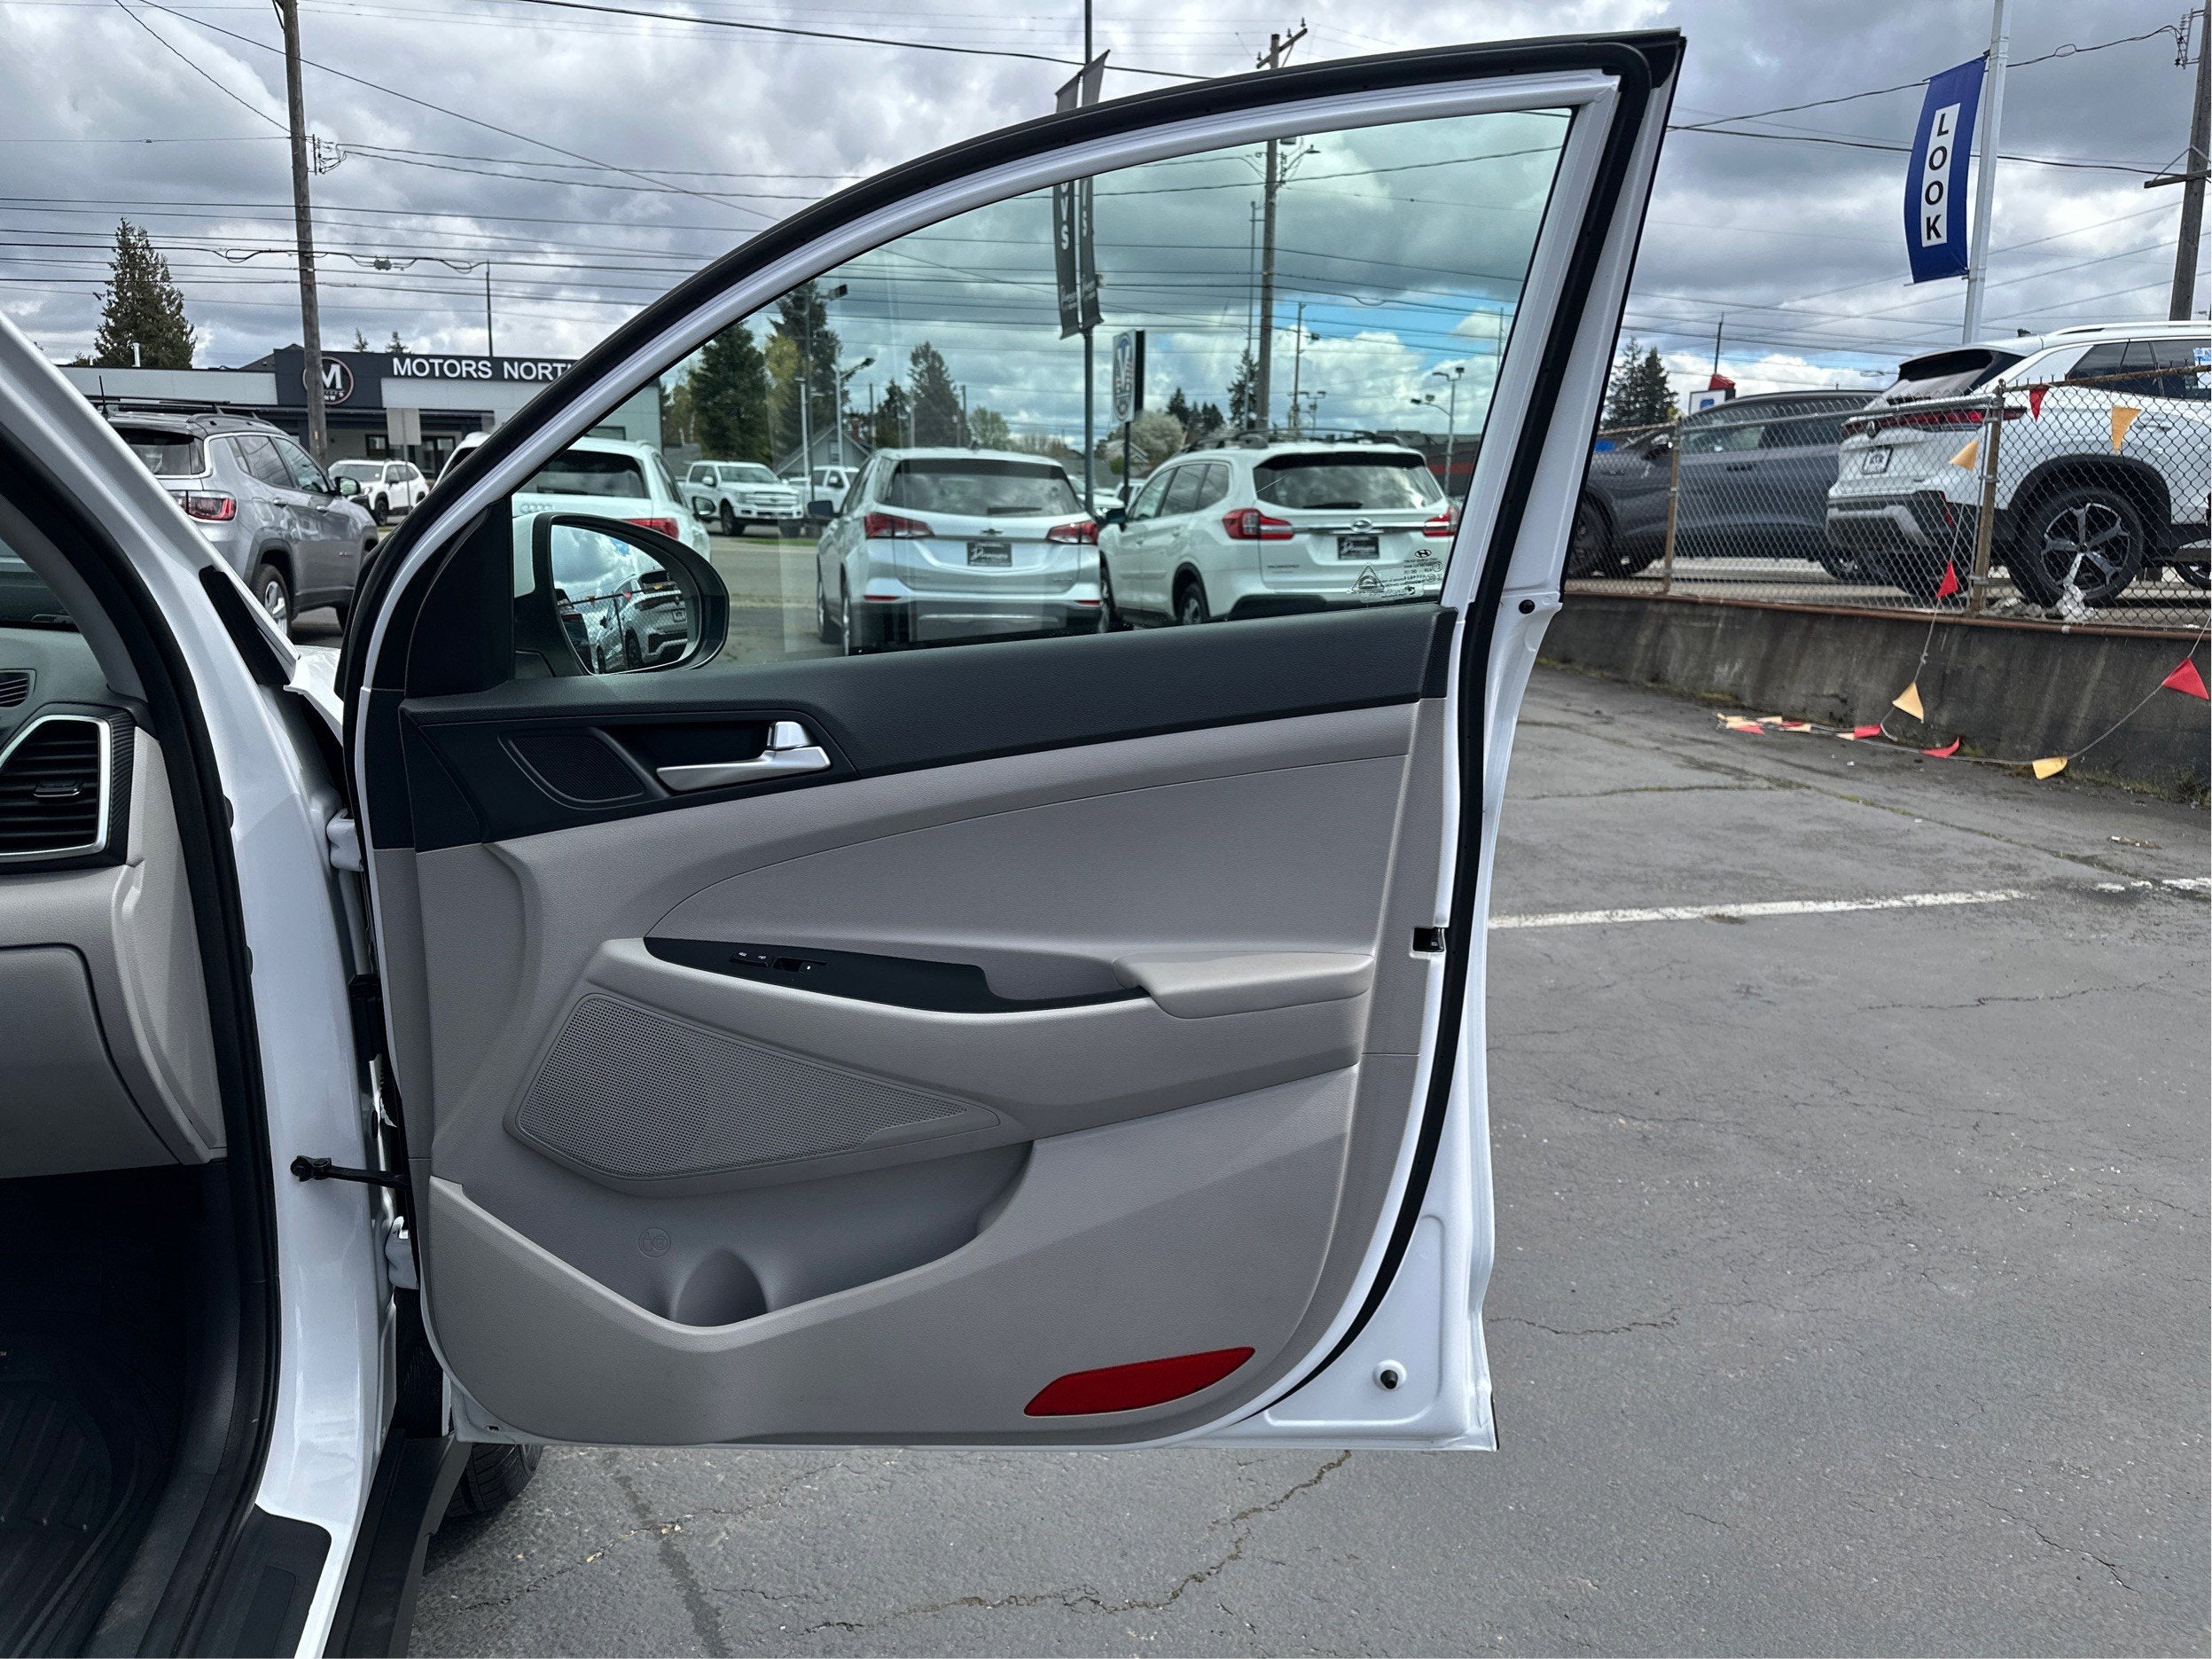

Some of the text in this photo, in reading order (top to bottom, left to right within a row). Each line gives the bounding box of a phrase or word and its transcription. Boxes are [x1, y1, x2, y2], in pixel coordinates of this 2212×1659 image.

[1924, 113, 1950, 240] LOOK
[392, 356, 572, 380] MOTORS NORT
